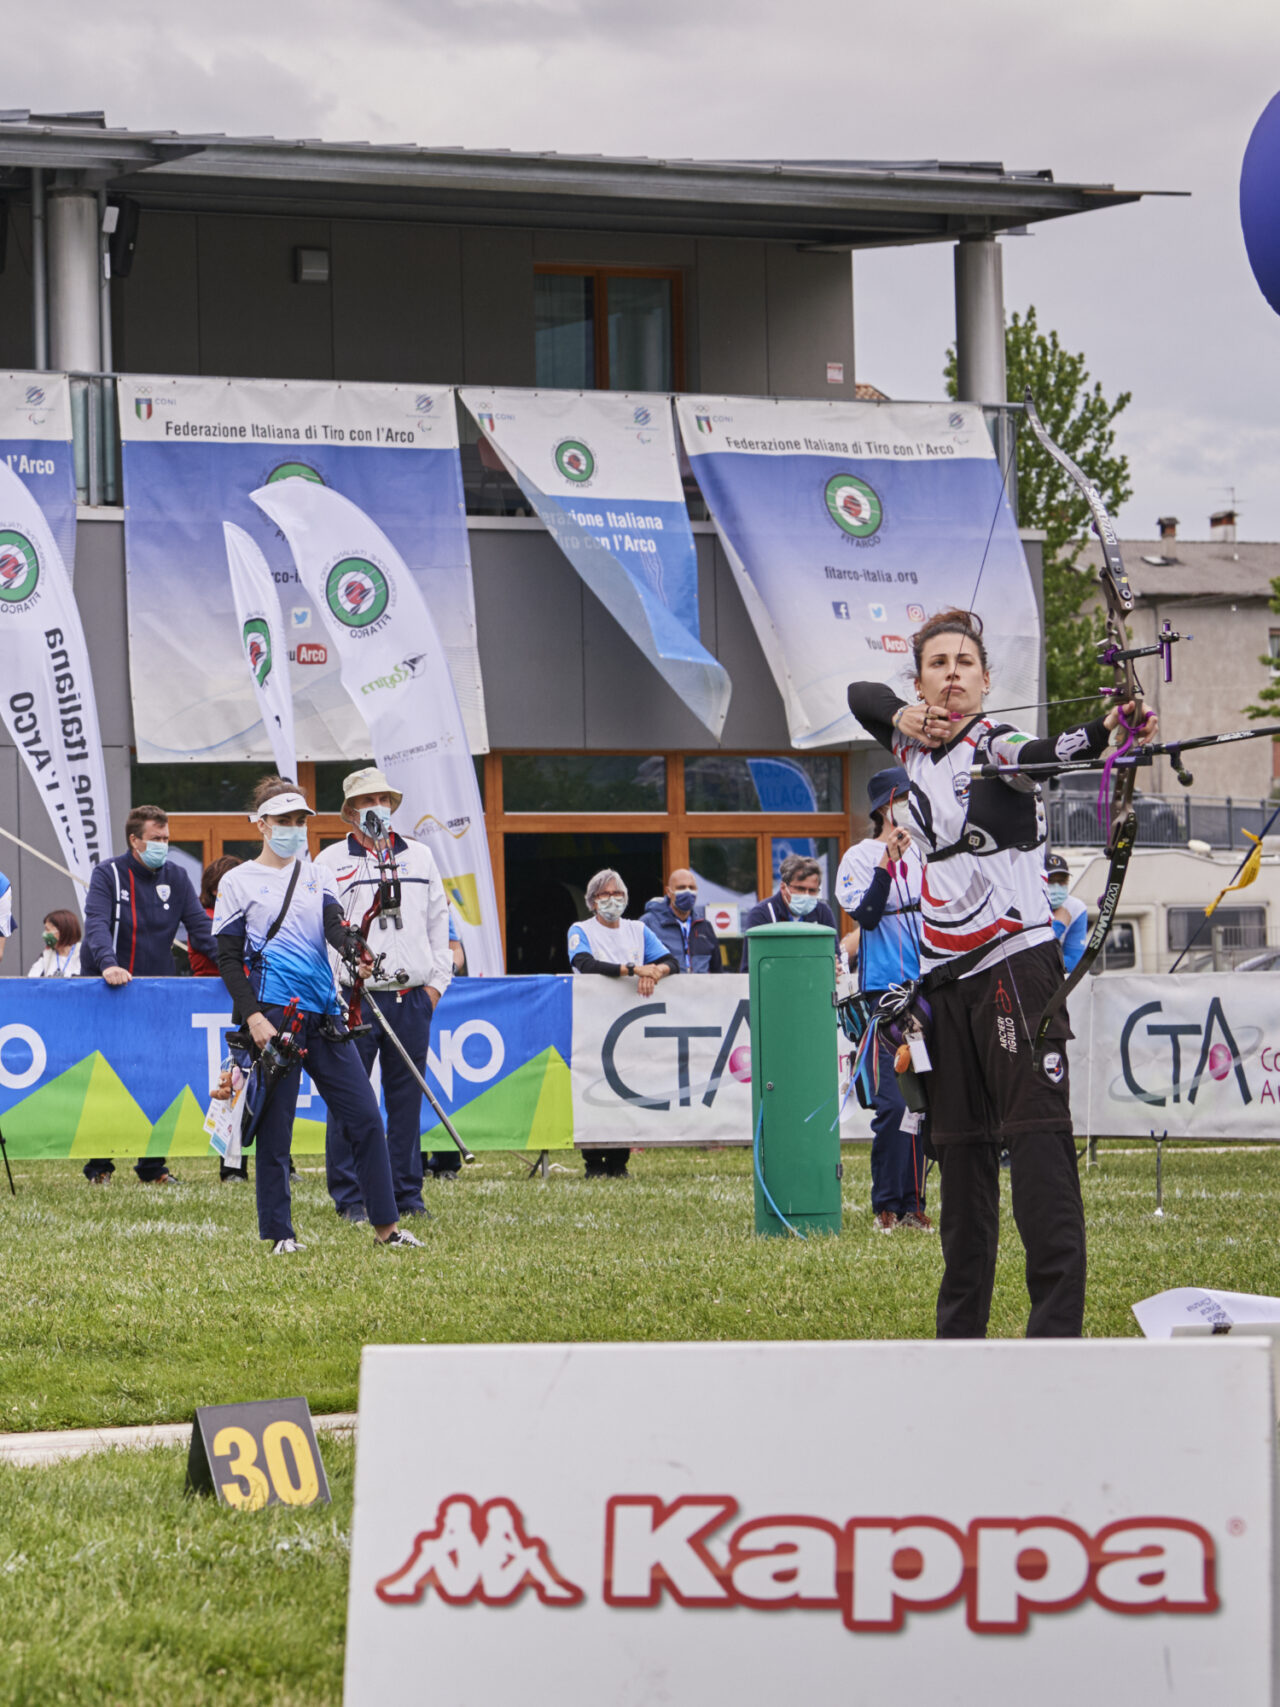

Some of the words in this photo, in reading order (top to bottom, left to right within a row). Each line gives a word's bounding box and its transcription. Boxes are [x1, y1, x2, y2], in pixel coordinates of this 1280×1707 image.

[495, 413, 516, 421] CONI
[165, 421, 247, 438] Federazione
[251, 423, 300, 439] Italiana
[305, 425, 317, 439] di
[321, 425, 345, 441] Tiro
[349, 429, 372, 441] con
[376, 427, 415, 443] l'Arco
[725, 436, 801, 450] Federazione
[803, 438, 849, 453] Italiana
[851, 441, 862, 454] di
[865, 441, 890, 455] Tiro
[893, 445, 914, 456] con
[916, 443, 955, 456] l'Arco
[6, 454, 55, 474] l'Arco
[606, 511, 664, 530] Italiana
[613, 534, 657, 553] l'Arco
[841, 533, 881, 548] FITARCO
[825, 566, 919, 585] fitarco-italia.org
[996, 1016, 1008, 1050] ARCIERI
[1006, 1017, 1018, 1054] TIGULLIO
[1120, 997, 1253, 1107] CTA
[213, 1420, 319, 1511] 30
[604, 1494, 1221, 1635] Kappa
